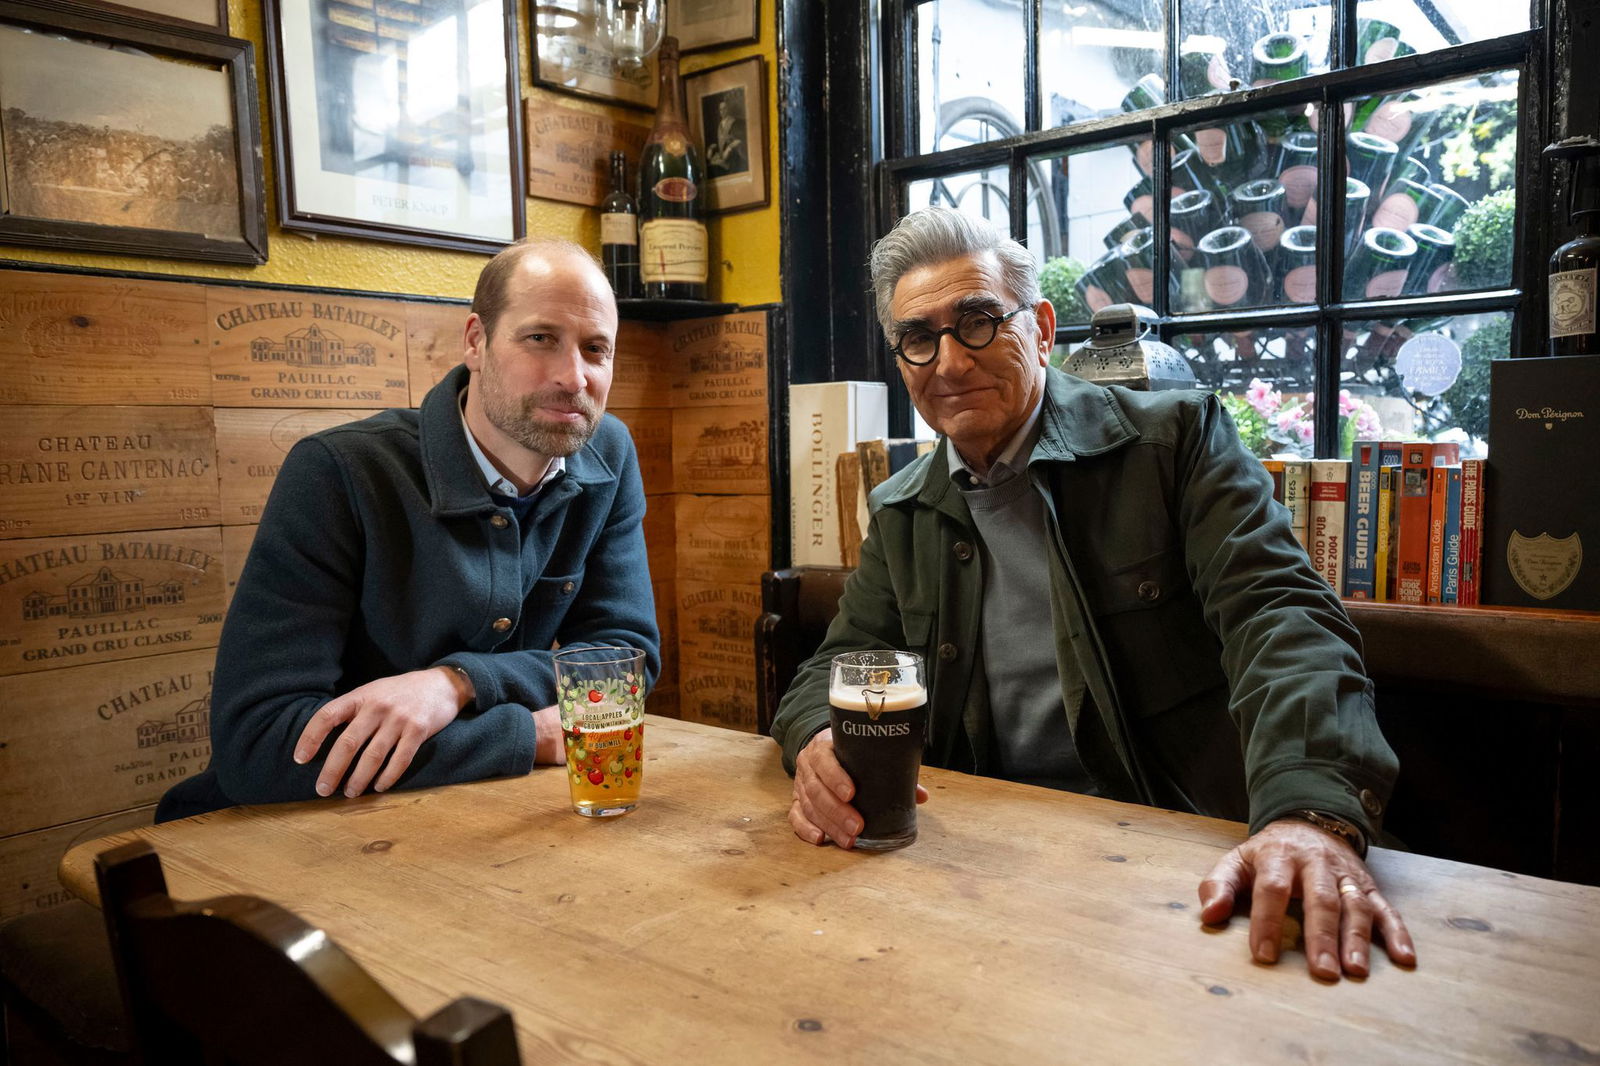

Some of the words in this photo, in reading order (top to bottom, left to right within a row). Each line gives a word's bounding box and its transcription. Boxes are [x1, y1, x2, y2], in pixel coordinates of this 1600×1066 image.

[216, 301, 303, 331] CHATEAU
[312, 302, 401, 341] BATAILLEY
[672, 321, 721, 353] CHATEAU
[724, 321, 765, 337] BATAIL
[277, 372, 358, 385] PAUILLAC
[704, 377, 752, 388] PAUILLAC
[251, 387, 301, 399] GRAND
[304, 388, 334, 400] CRU
[336, 389, 383, 401] CLASSE
[688, 390, 718, 401] GRAND
[719, 390, 738, 399] CRU
[738, 389, 765, 398] CLASS
[1515, 407, 1541, 419] Dom
[1541, 406, 1585, 422] Pérignon
[37, 434, 152, 452] CHATEAU
[0, 461, 71, 485] RANE
[80, 457, 206, 481] CANTENAC
[247, 464, 283, 477] CHAT
[811, 412, 824, 547] BOLLINGER
[1465, 460, 1477, 478] THE
[97, 490, 136, 504] VIN
[1288, 479, 1297, 502] REES
[1357, 470, 1371, 515] BEER
[1464, 479, 1477, 503] PARIS
[1316, 516, 1327, 537] PUB
[1463, 503, 1476, 531] GUIDE
[1431, 519, 1442, 543] Guide
[1328, 535, 1338, 561] 2004
[1355, 519, 1369, 570] GUIDE
[1446, 534, 1459, 568] Guide
[0, 545, 89, 585] HATEAU
[100, 542, 216, 572] BATAILLEY
[1314, 542, 1326, 572] GOOD
[1327, 561, 1337, 591] UIDE
[1430, 545, 1441, 593] Amsterdam
[1445, 568, 1457, 595] Paris
[732, 589, 762, 608] BATAI
[58, 617, 160, 640] PAUILLAC
[22, 643, 88, 662] GRAND
[92, 639, 129, 653] CRU
[133, 629, 194, 648] CLASSE
[712, 640, 754, 655] PAUILLA
[97, 673, 193, 721] CHATEAU
[582, 713, 600, 721] LOCAL
[601, 710, 623, 720] APPLES
[583, 721, 605, 730] GROWN
[842, 720, 910, 737] GUINNESS
[169, 745, 211, 763] PAUI
[608, 739, 621, 747] MILL
[134, 766, 187, 786] GRAND
